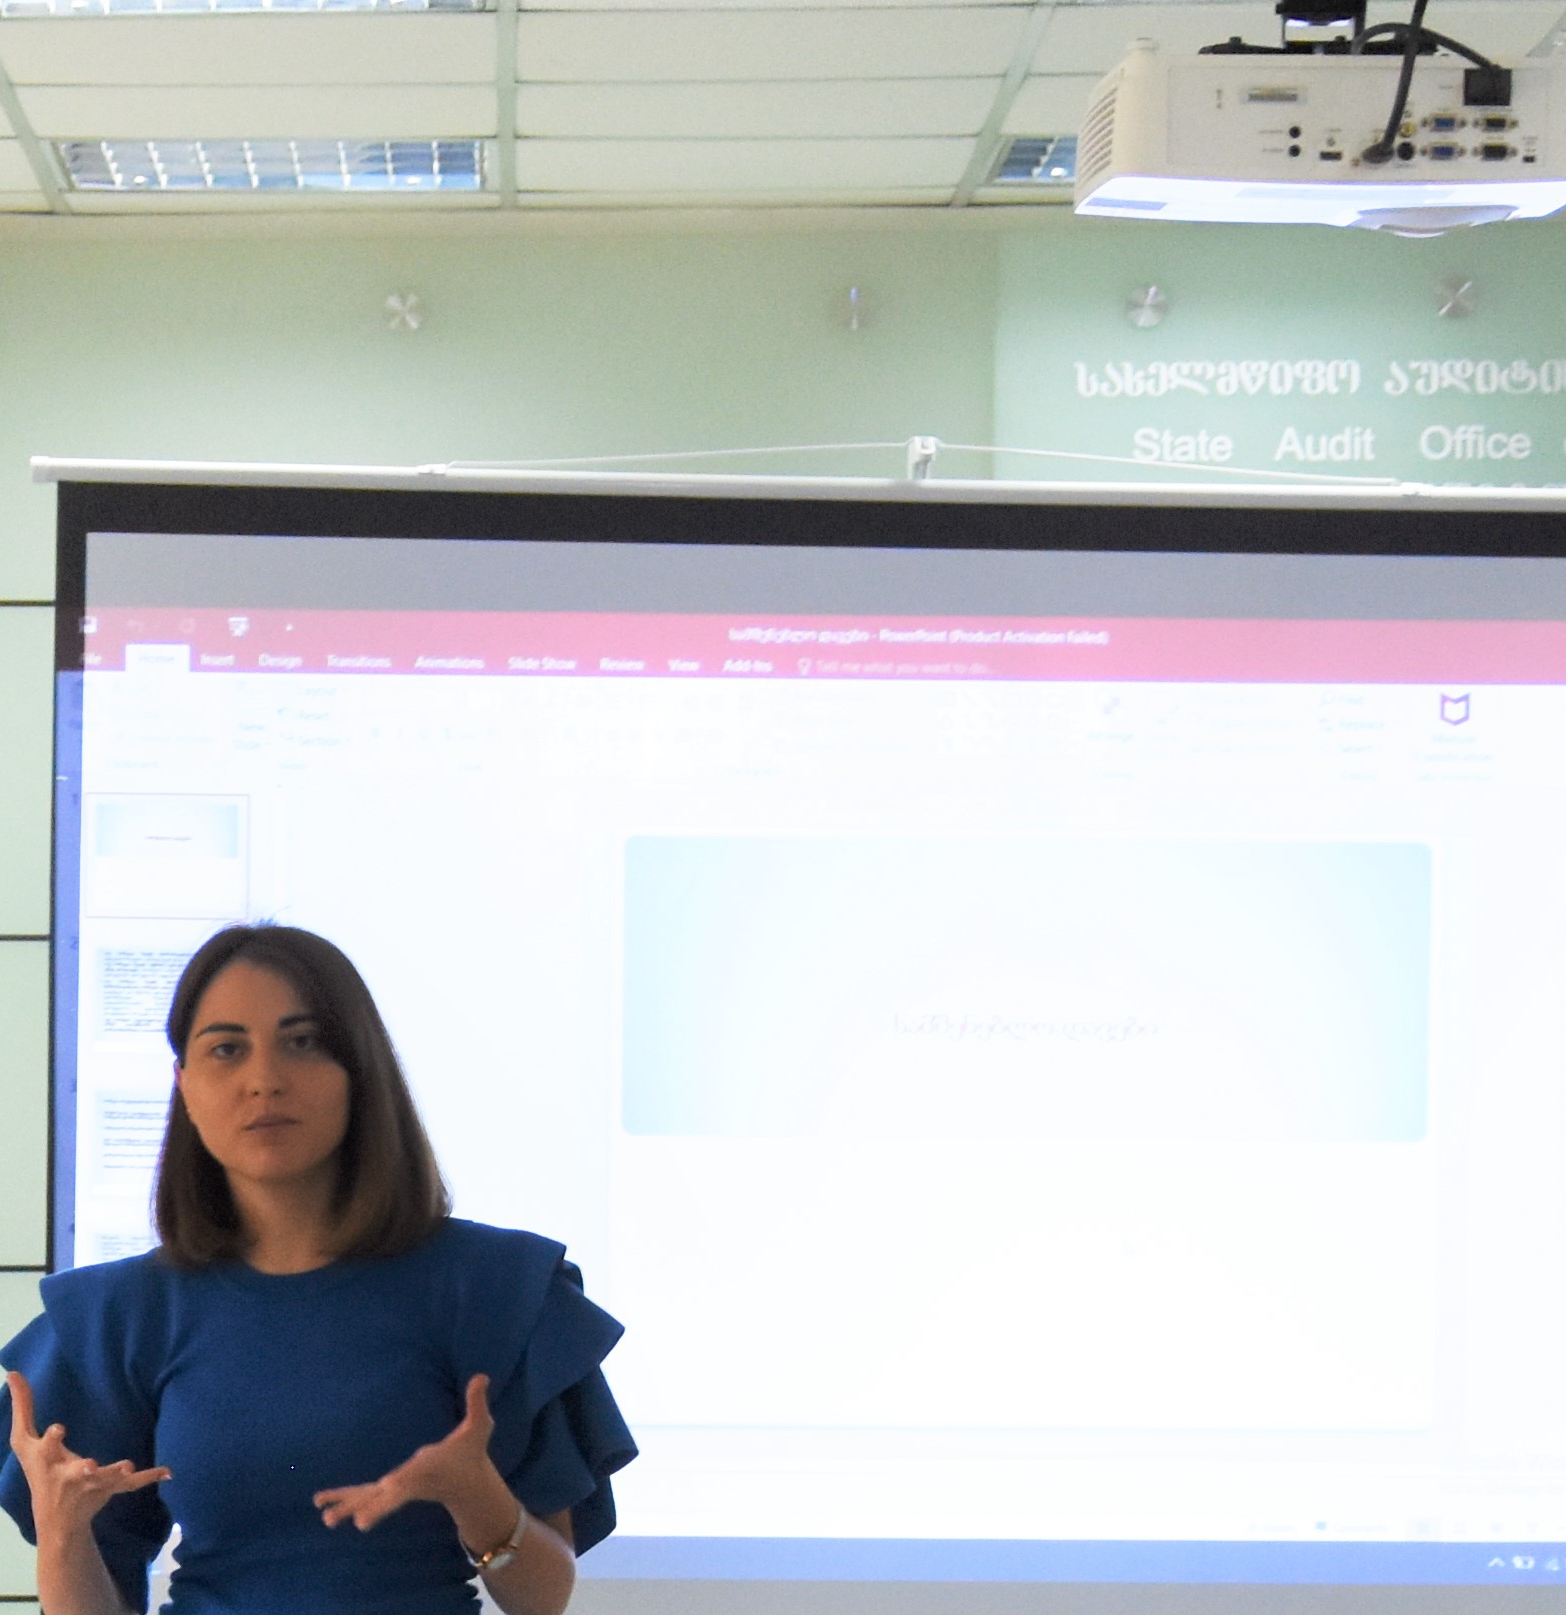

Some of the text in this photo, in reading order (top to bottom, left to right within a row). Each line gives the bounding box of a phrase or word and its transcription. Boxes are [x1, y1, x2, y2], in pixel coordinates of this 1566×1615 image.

[1134, 427, 1233, 462] State
[1274, 427, 1376, 461] Audit
[1419, 424, 1532, 460] Office
